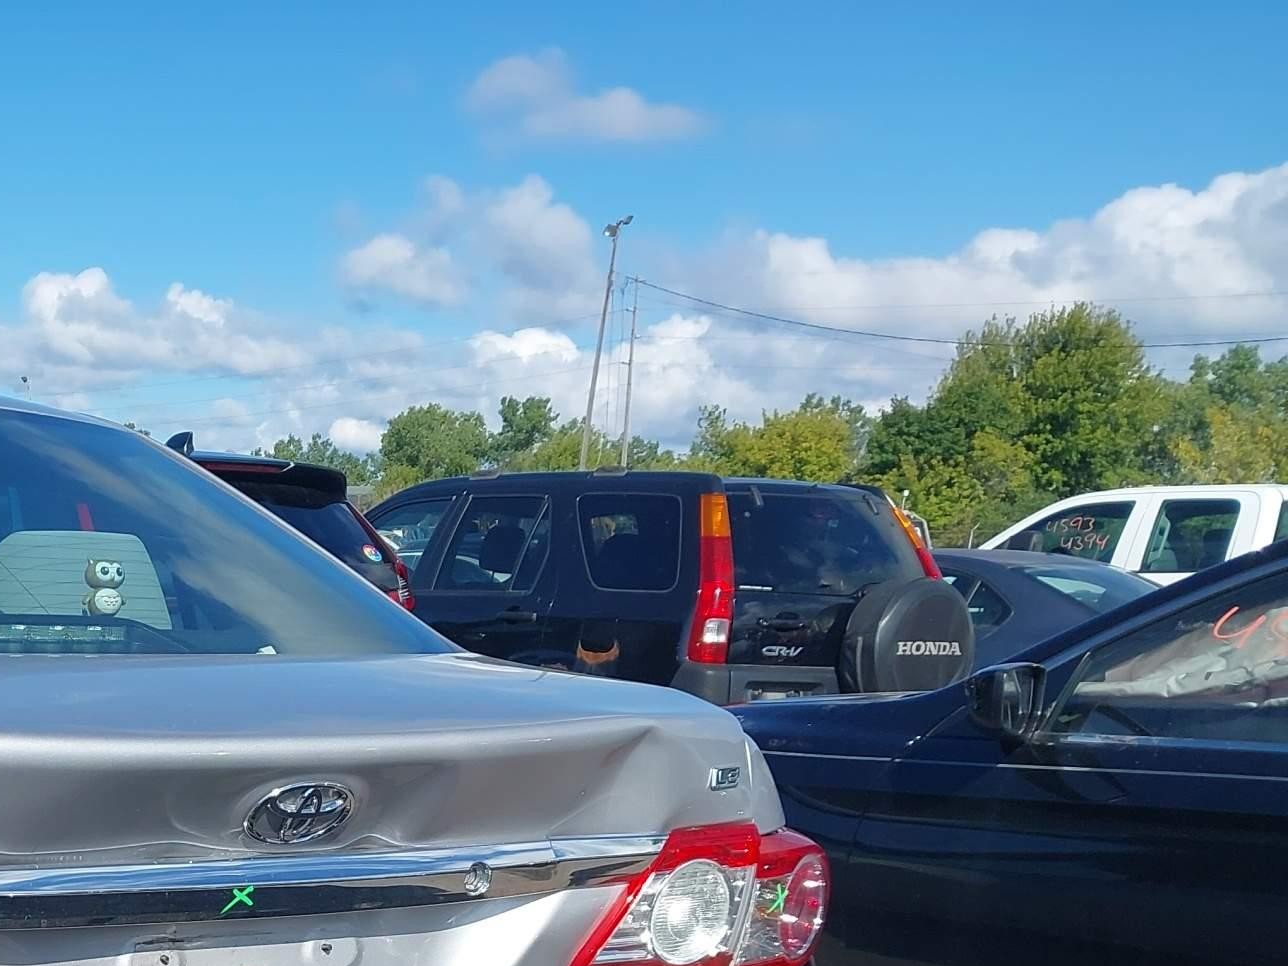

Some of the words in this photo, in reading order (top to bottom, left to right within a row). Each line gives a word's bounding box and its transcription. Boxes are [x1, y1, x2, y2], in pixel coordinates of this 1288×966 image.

[1046, 516, 1096, 533] 4593
[1060, 533, 1110, 550] 4394
[896, 641, 962, 656] HONDA
